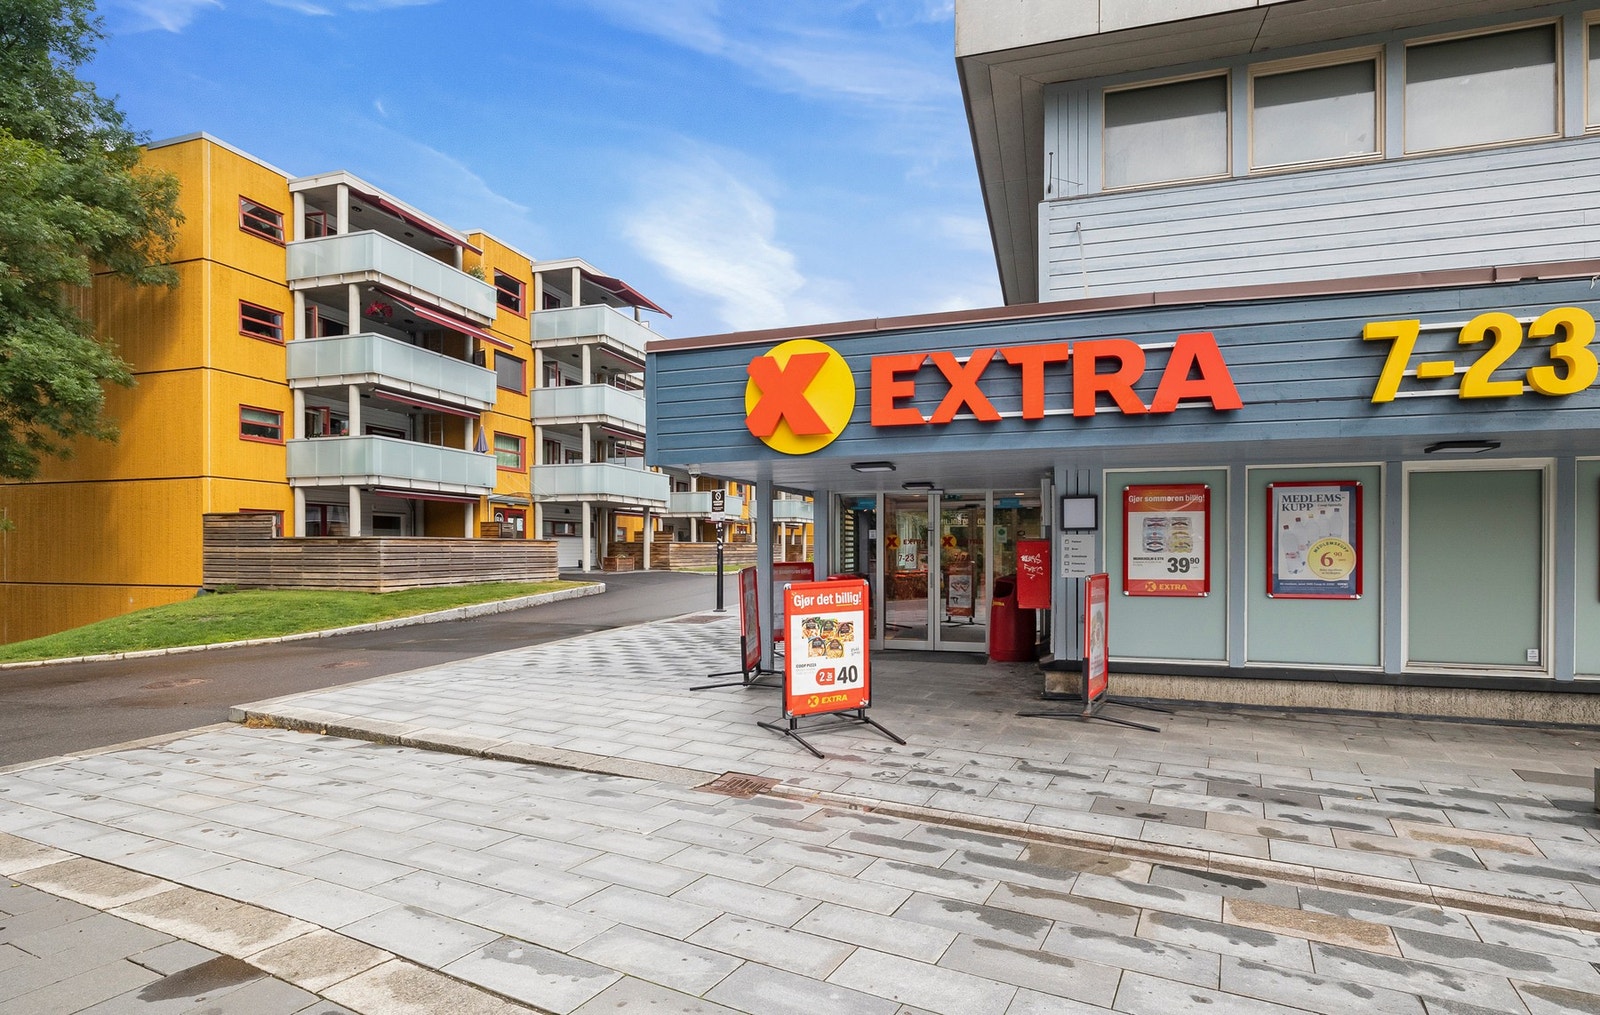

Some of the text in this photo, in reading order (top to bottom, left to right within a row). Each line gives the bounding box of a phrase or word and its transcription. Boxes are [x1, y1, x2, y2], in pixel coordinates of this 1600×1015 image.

[1363, 306, 1599, 403] 7-23
[870, 331, 1244, 427] EXTRA
[1128, 495, 1143, 503] Gjør
[1185, 494, 1205, 503] billig!
[1281, 493, 1345, 503] MEDLEMS-
[1281, 503, 1314, 512] KUPP
[899, 554, 915, 562] 7-23
[1167, 557, 1190, 573] 39
[1320, 551, 1334, 567] 6
[793, 591, 862, 609] Gjør det billig!
[819, 671, 825, 682] 2
[837, 665, 858, 684] 40
[821, 694, 848, 704] EXTRA
